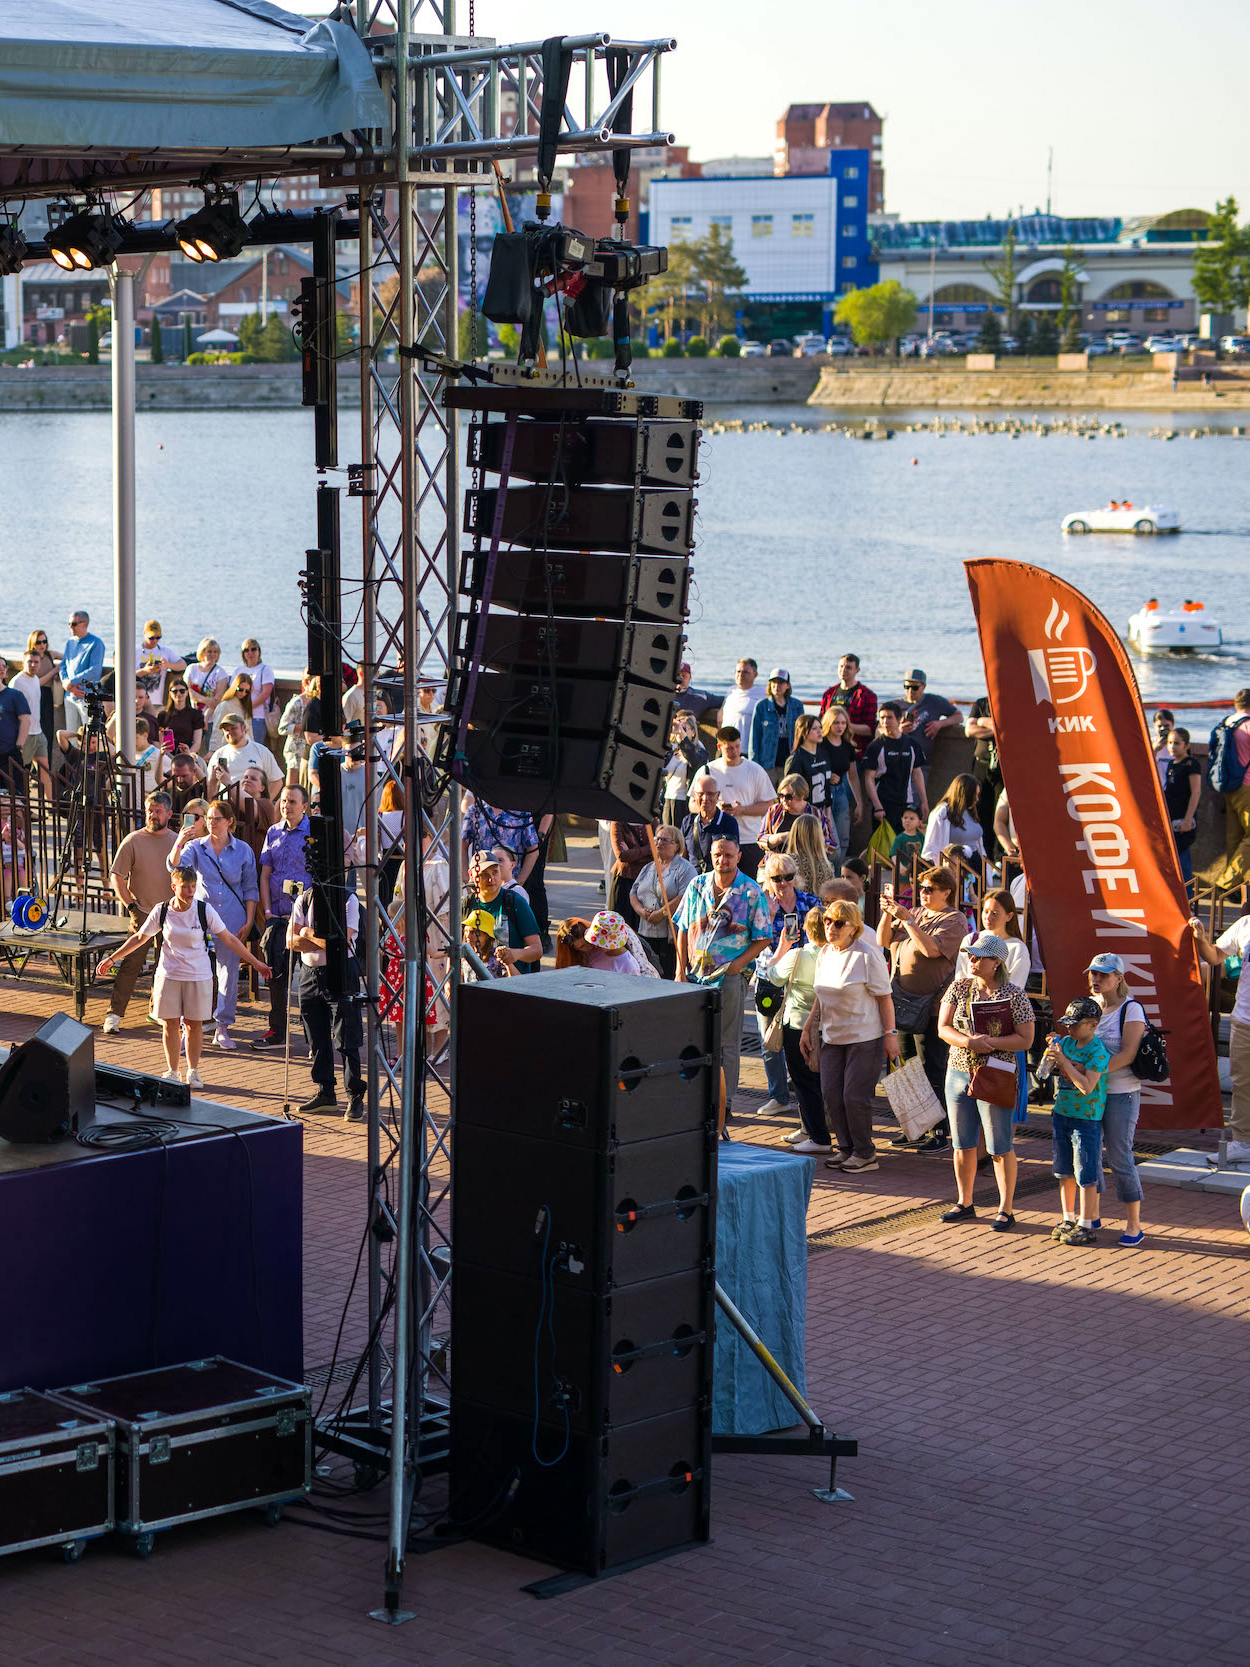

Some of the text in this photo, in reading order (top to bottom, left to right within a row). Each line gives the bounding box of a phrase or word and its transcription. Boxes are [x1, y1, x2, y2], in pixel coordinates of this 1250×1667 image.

[1048, 716, 1097, 733] КИК
[1058, 763, 1140, 894] КОФЕ
[1091, 909, 1148, 937] И
